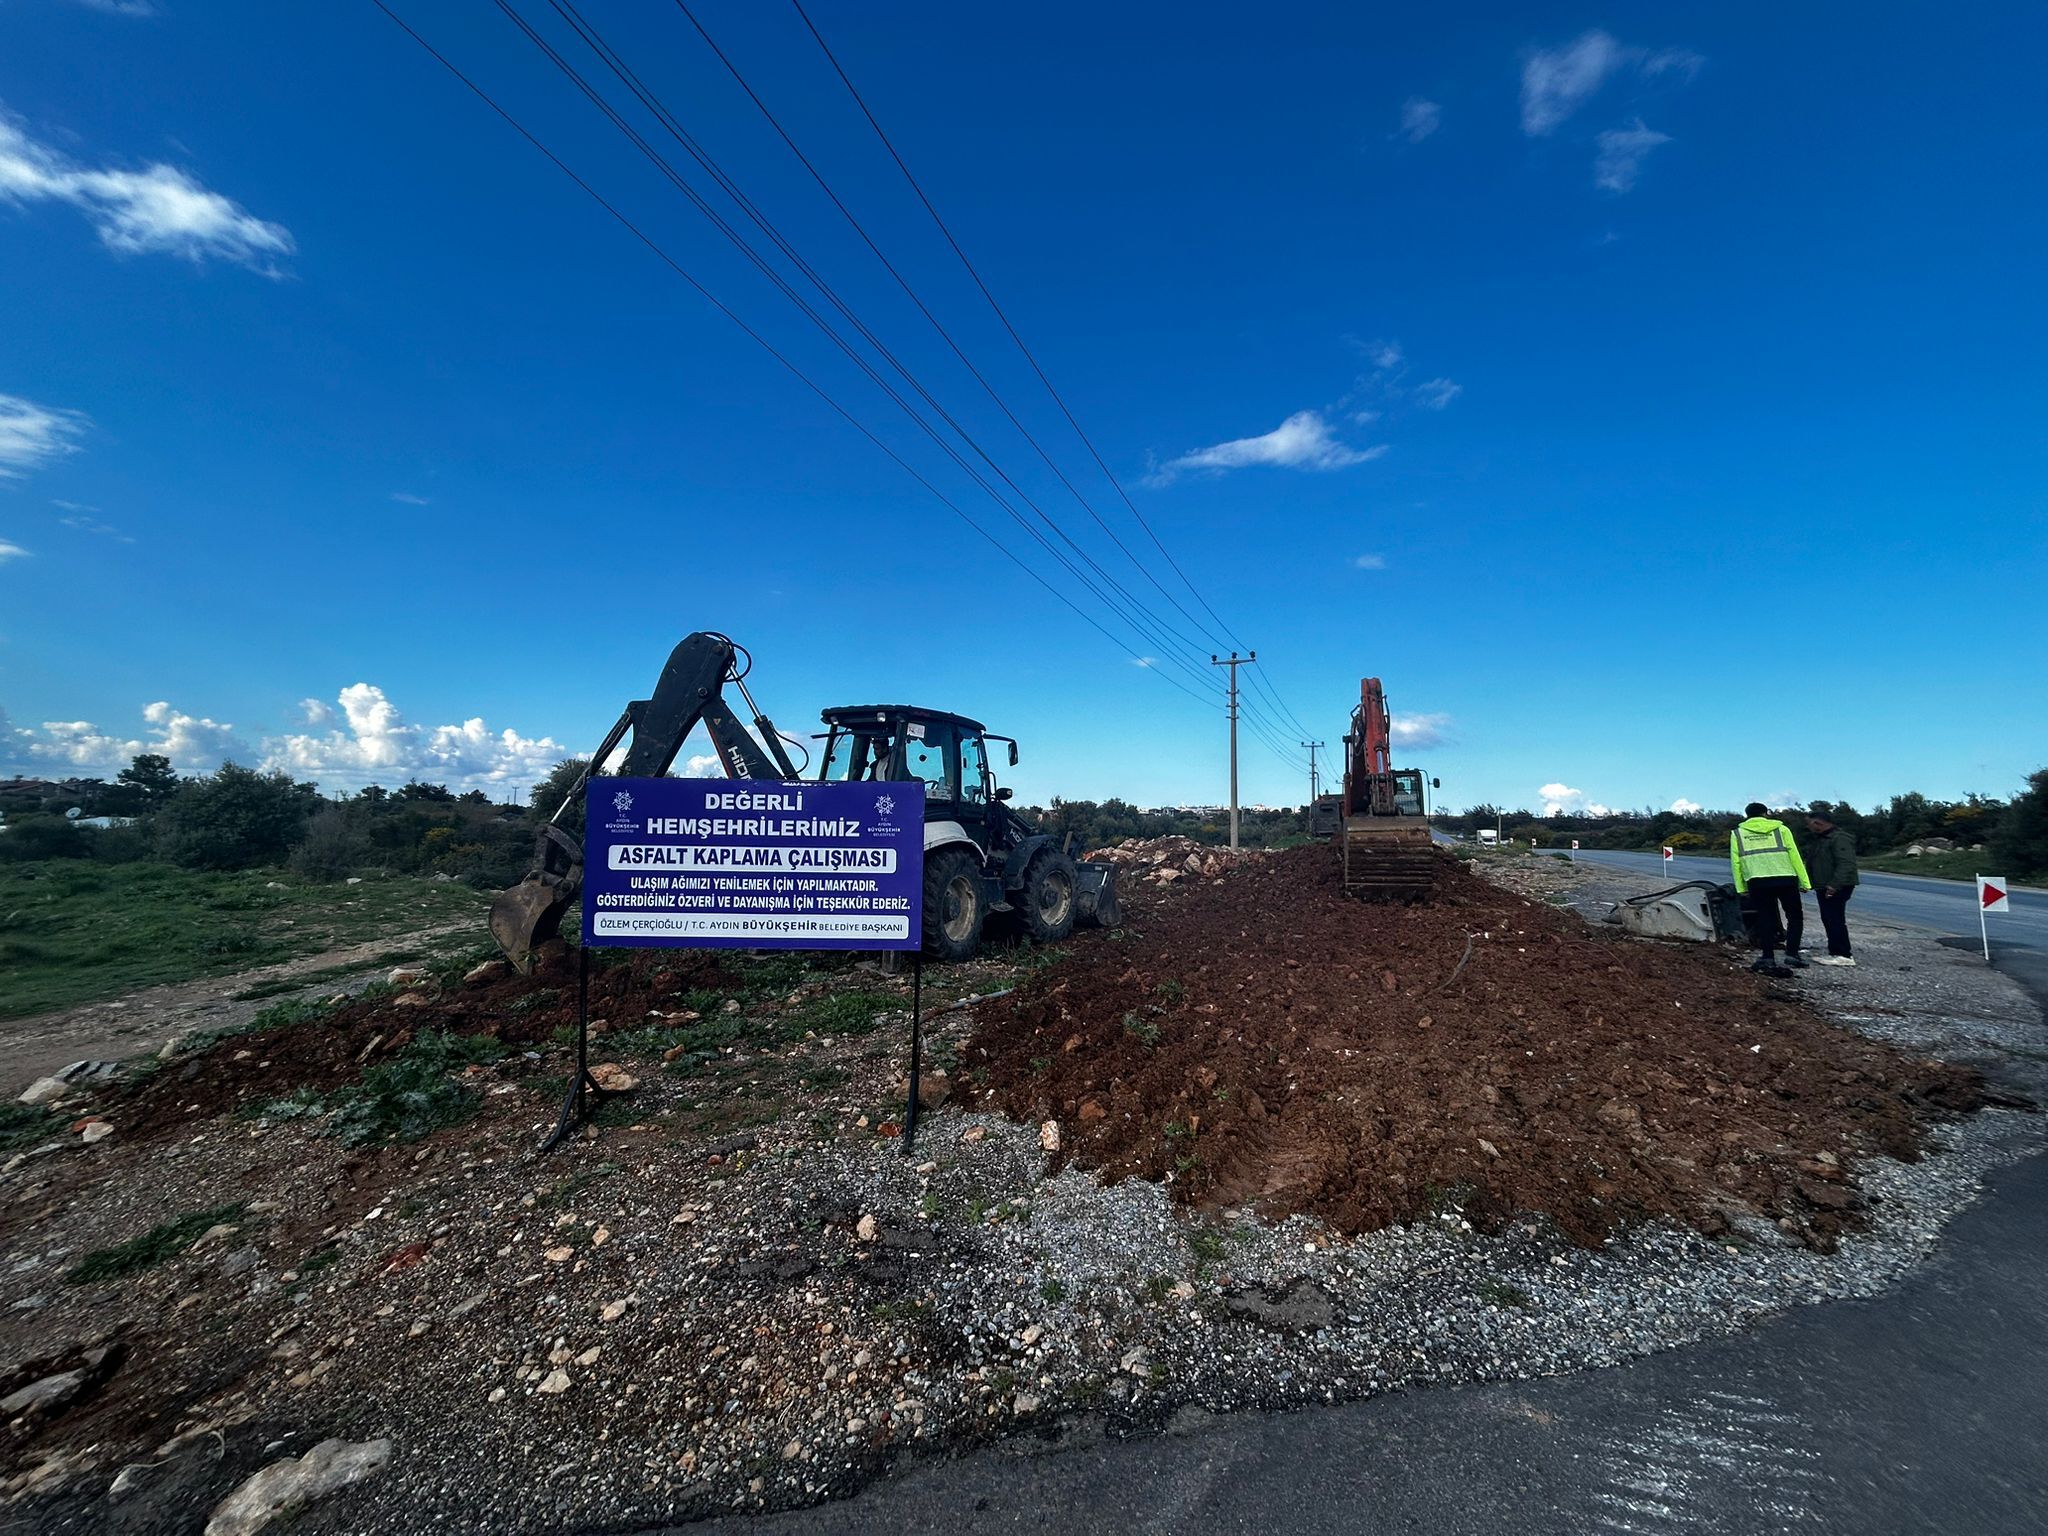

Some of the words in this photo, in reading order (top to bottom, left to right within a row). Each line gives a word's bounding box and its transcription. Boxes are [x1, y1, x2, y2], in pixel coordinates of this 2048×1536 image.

[705, 790, 803, 811] DEĞERLİ
[647, 816, 860, 840] HEMŞEHRİLERİMİZ
[618, 847, 688, 865] ASFALT
[693, 848, 783, 866] KAPLAMA
[788, 849, 887, 871] ÇALIŞMASI
[630, 877, 669, 891] ULAŞIM
[671, 875, 710, 890] AĞIMIZI
[713, 876, 771, 890] YENİLEMEK
[773, 877, 794, 893] İÇİN
[797, 879, 879, 891] YAPILMAKTADIR.
[596, 892, 676, 907] GÖSTERDİĞİNİZ
[678, 893, 715, 907] ÖZVERİ
[717, 896, 731, 907] VE
[733, 896, 791, 911] DAYANIŞMA
[793, 894, 814, 911] İÇİN
[817, 896, 870, 911] TEŞEKKÜR
[872, 896, 911, 909] EDERİZ.
[600, 918, 630, 929] ÖZLEM
[632, 918, 683, 931] ÇERÇİOĞLU
[684, 920, 689, 931] /
[691, 921, 708, 929] T.C.
[709, 921, 740, 930] AYDIN
[742, 920, 818, 932] BÜYÜKŞEHİR
[819, 922, 860, 931] BELEDİYE
[861, 923, 903, 933] BAŞKANI
